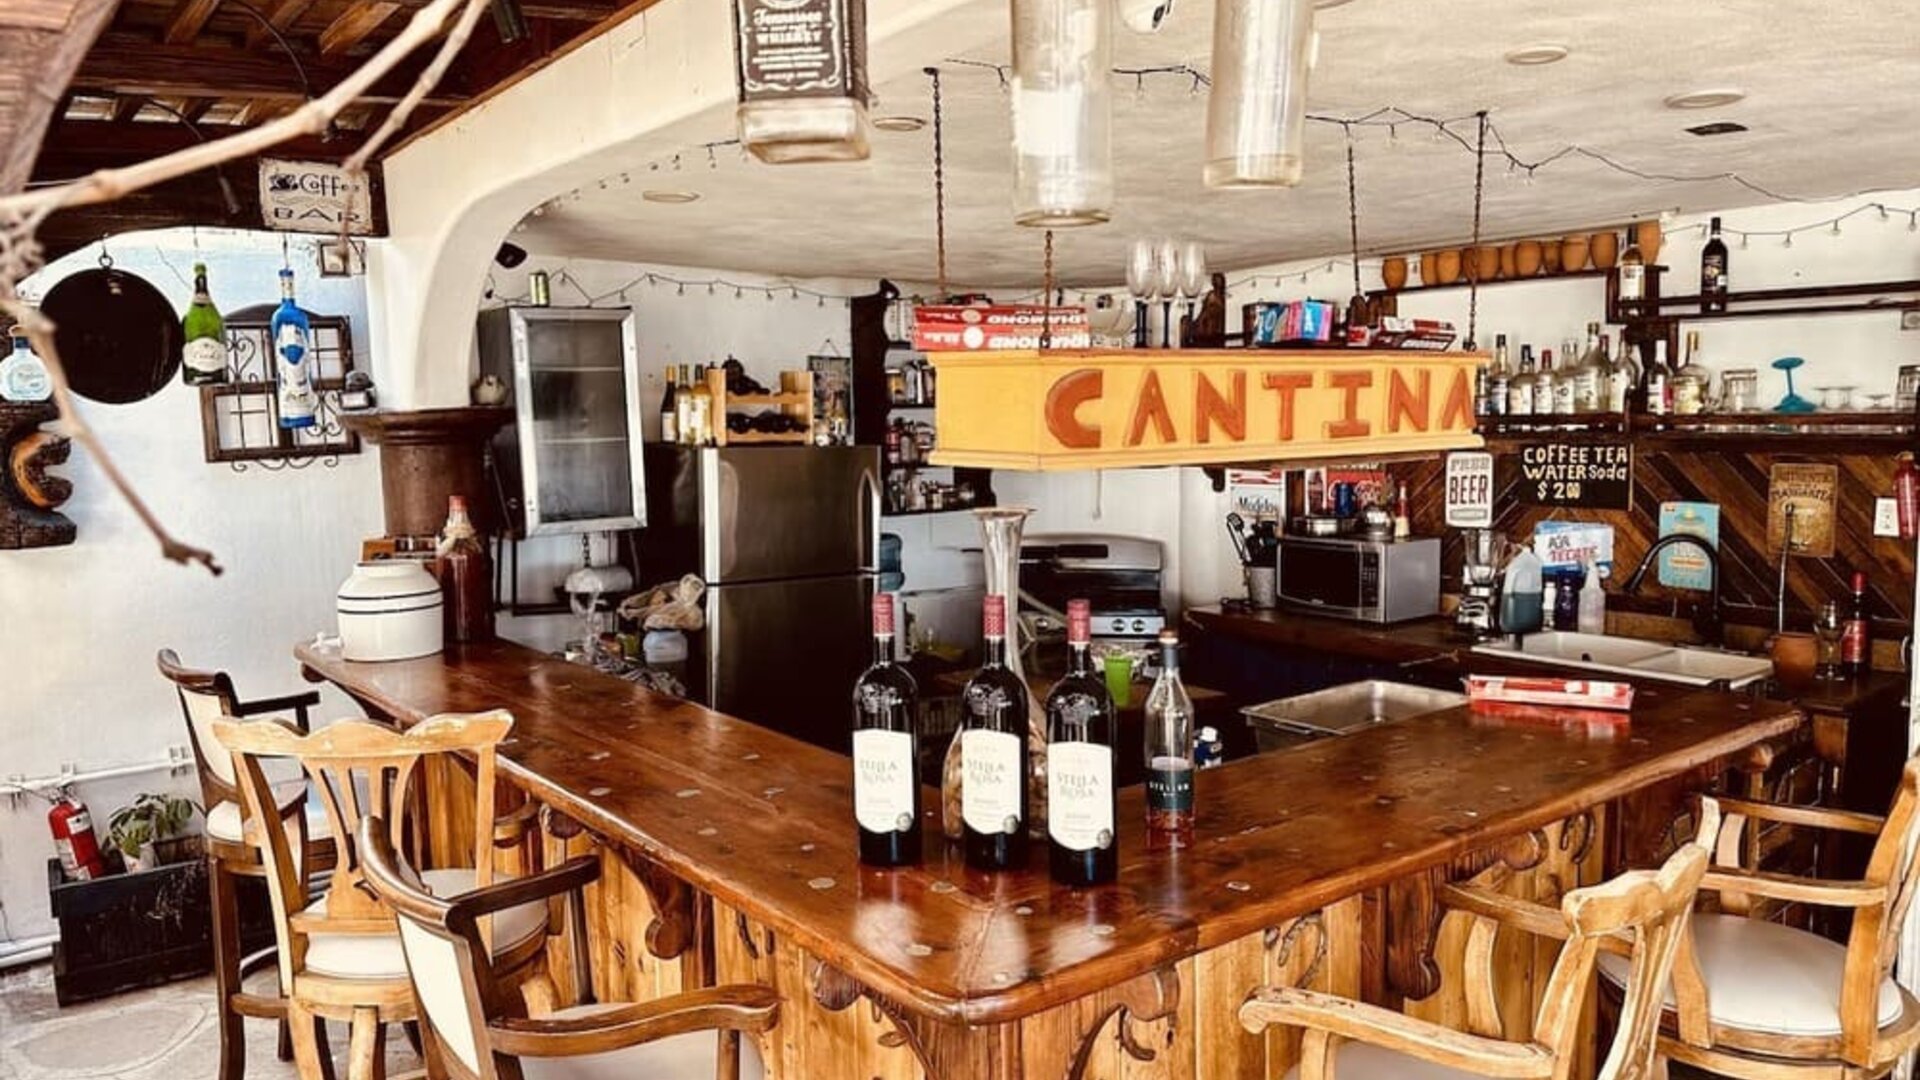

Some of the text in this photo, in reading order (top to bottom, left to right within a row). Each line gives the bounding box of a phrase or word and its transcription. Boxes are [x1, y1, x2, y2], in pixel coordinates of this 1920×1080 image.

[753, 8, 822, 25] Tennessee
[273, 207, 361, 223] BAR
[1044, 367, 1477, 449] CANTINA
[1523, 444, 1628, 464] COFFEE TEA
[1522, 463, 1628, 480] WATER Soda
[1449, 474, 1489, 505] BEER
